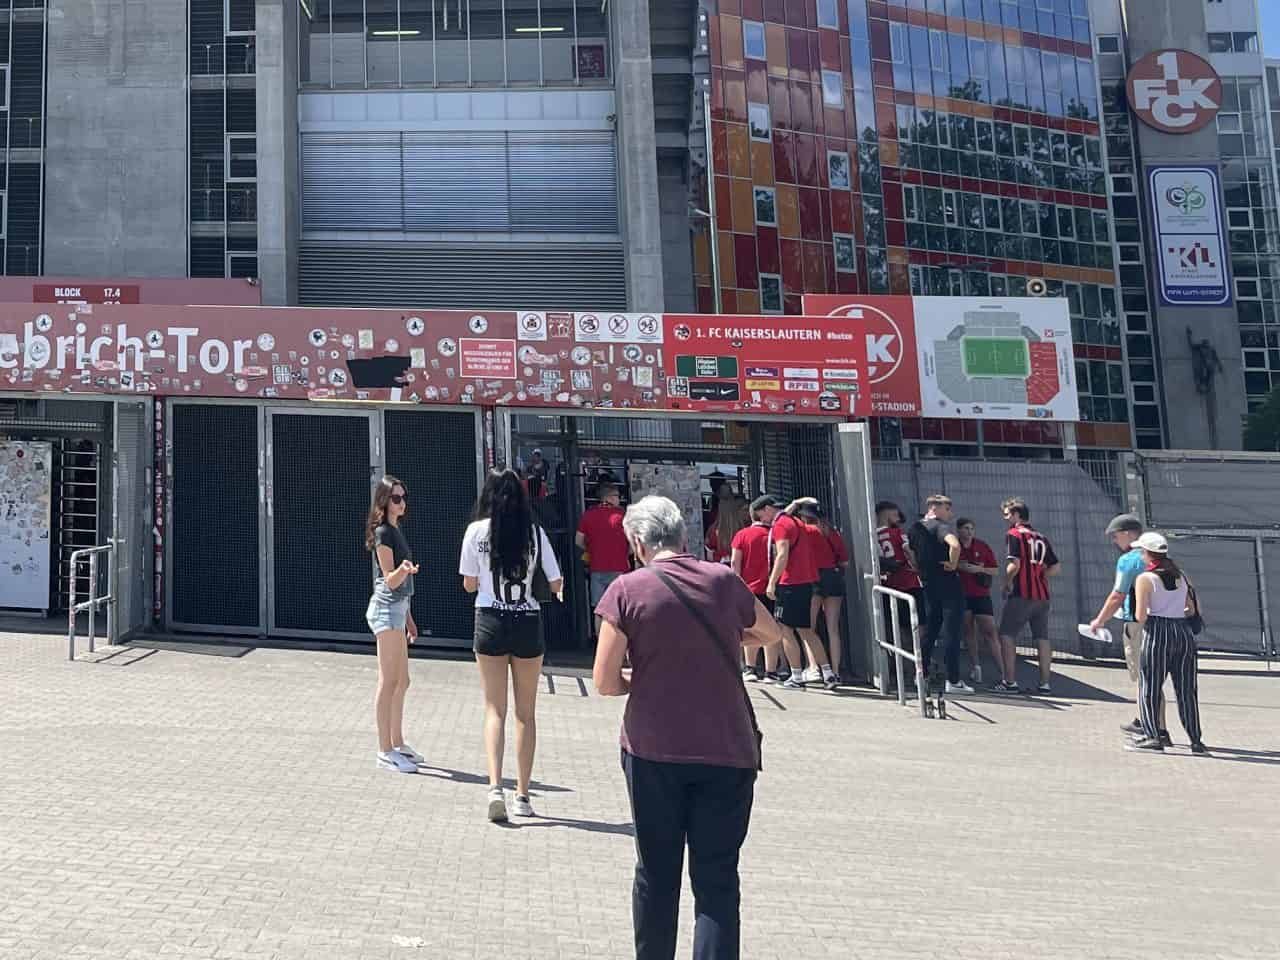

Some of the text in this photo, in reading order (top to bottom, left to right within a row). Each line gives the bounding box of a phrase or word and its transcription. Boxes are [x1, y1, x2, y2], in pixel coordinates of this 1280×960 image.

[54, 288, 121, 297] BLOCK 17.4
[696, 327, 706, 338] 1.
[708, 328, 722, 339] FC
[724, 328, 822, 340] KAISERSLAUTERN
